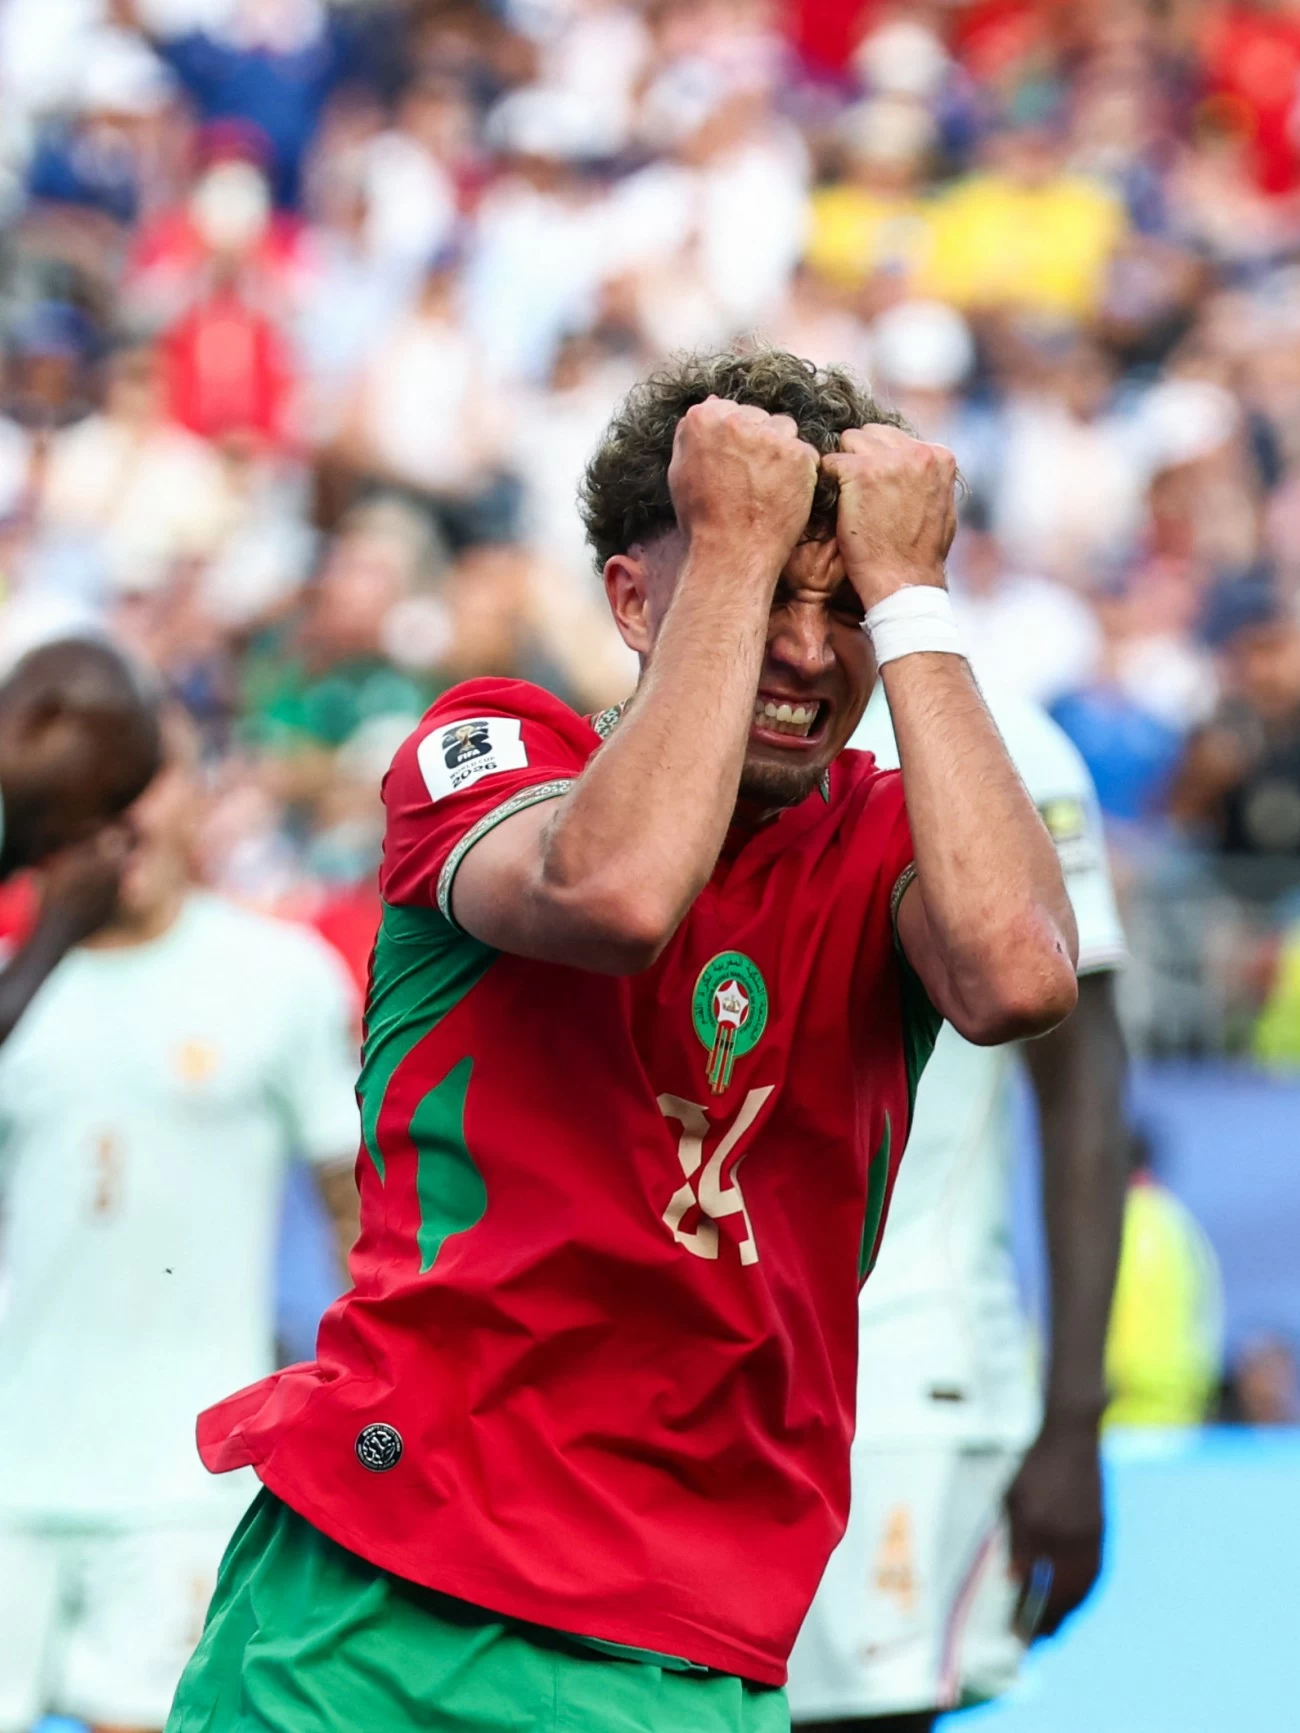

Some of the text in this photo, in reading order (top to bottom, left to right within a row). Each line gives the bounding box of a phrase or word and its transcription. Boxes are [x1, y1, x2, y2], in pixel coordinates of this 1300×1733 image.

[457, 748, 480, 762] FIFA
[452, 762, 497, 788] 2026
[656, 1084, 776, 1266] 24
